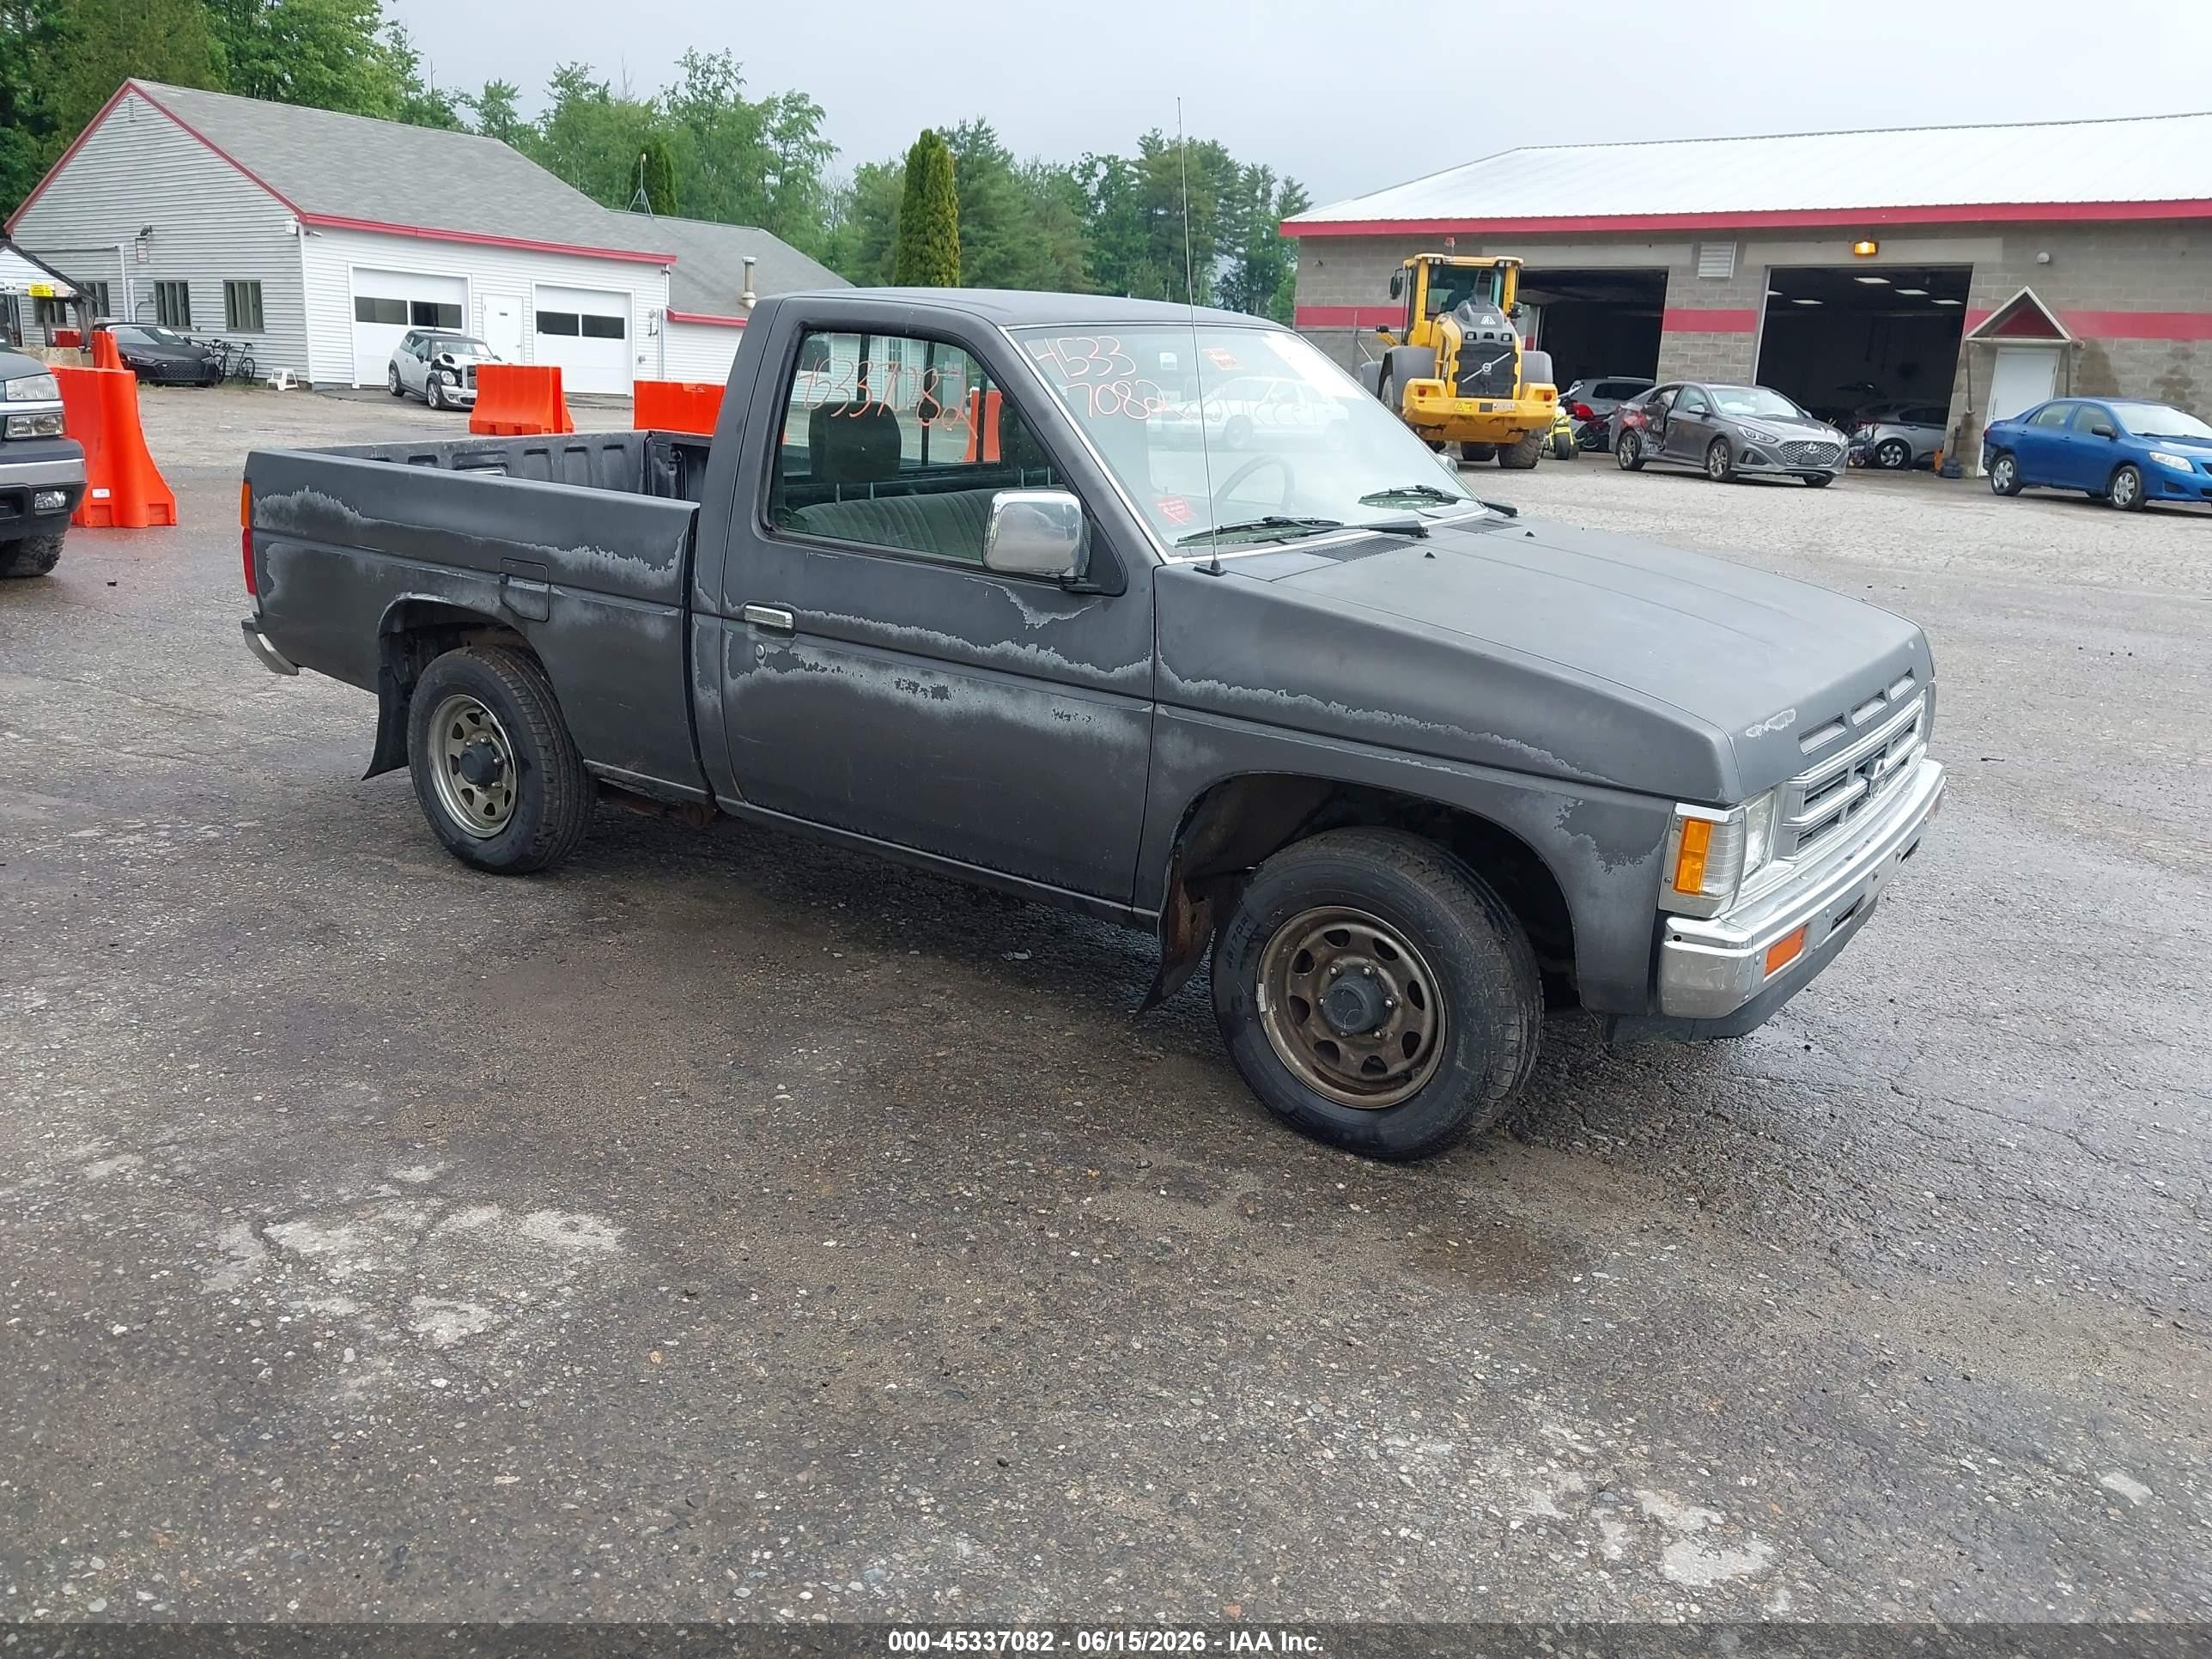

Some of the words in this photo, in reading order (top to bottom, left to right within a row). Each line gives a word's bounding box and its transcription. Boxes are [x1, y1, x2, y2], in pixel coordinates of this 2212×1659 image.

[1024, 336, 1137, 379] 4533
[796, 356, 978, 440] 45337082
[1063, 380, 1188, 420] 7082
